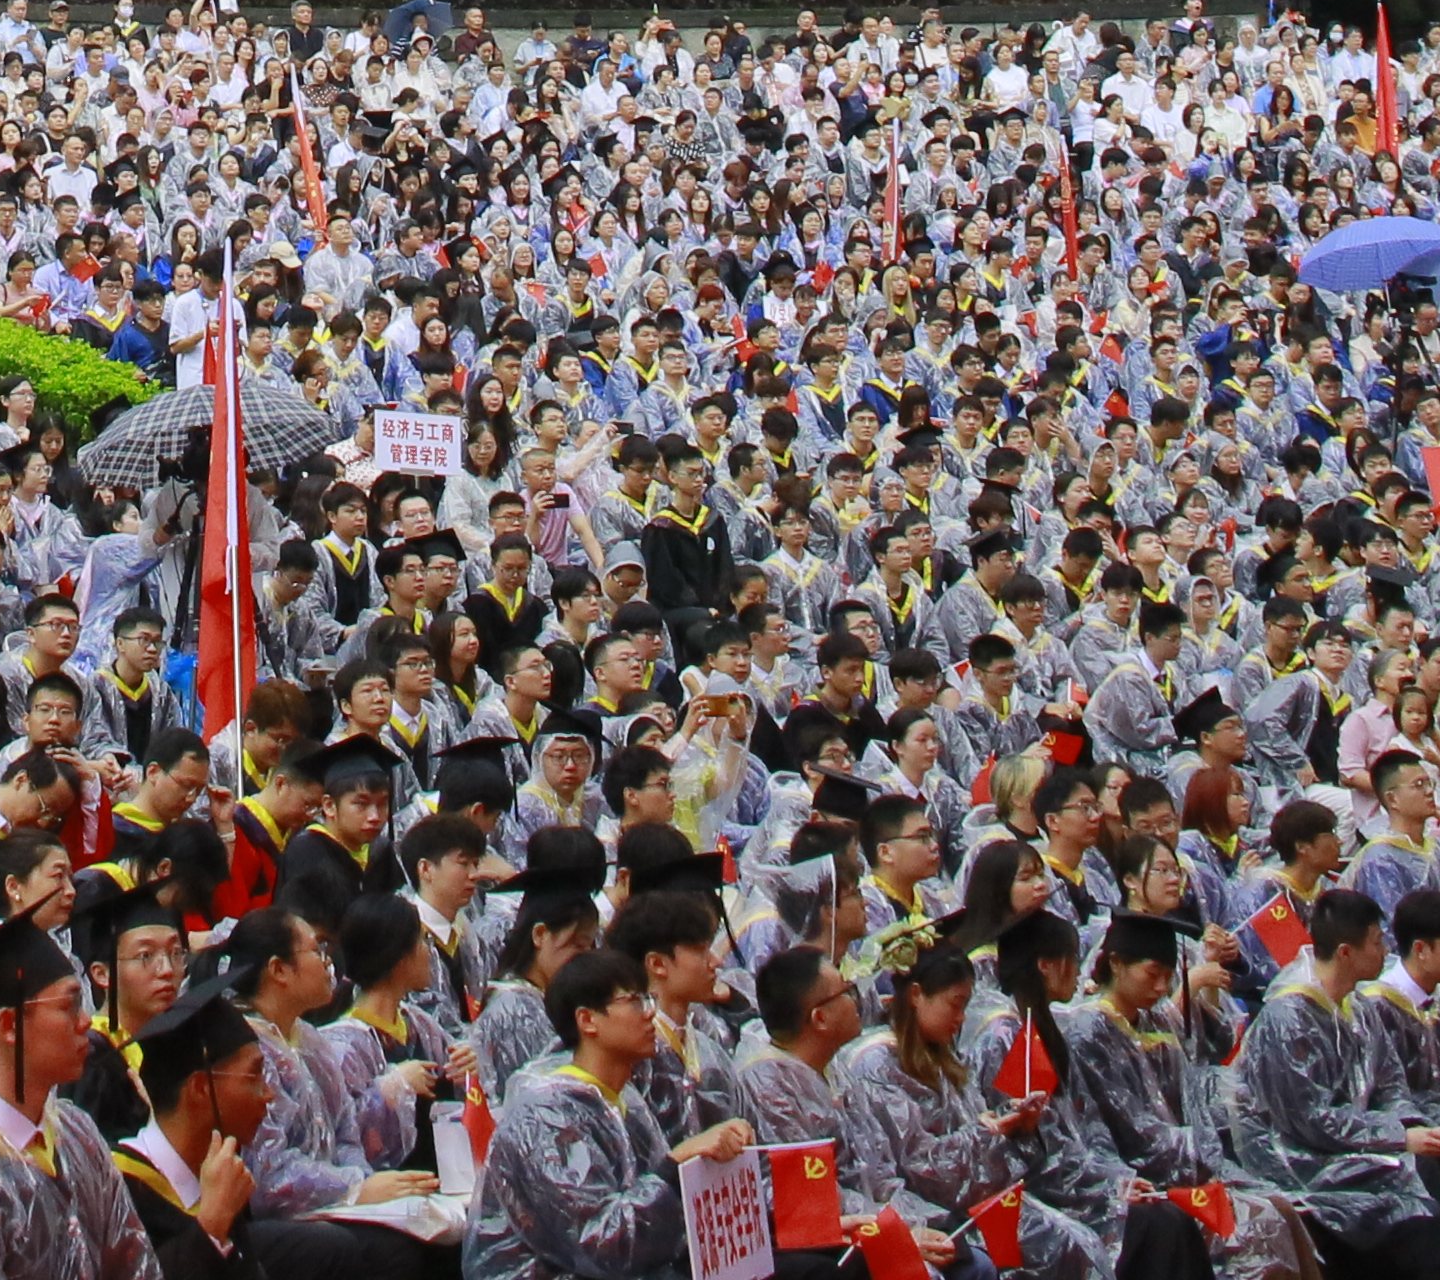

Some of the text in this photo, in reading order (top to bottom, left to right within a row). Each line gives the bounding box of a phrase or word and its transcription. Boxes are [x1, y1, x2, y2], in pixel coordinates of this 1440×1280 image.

[382, 418, 454, 443] 经济与工商
[390, 443, 448, 467] 管理学院
